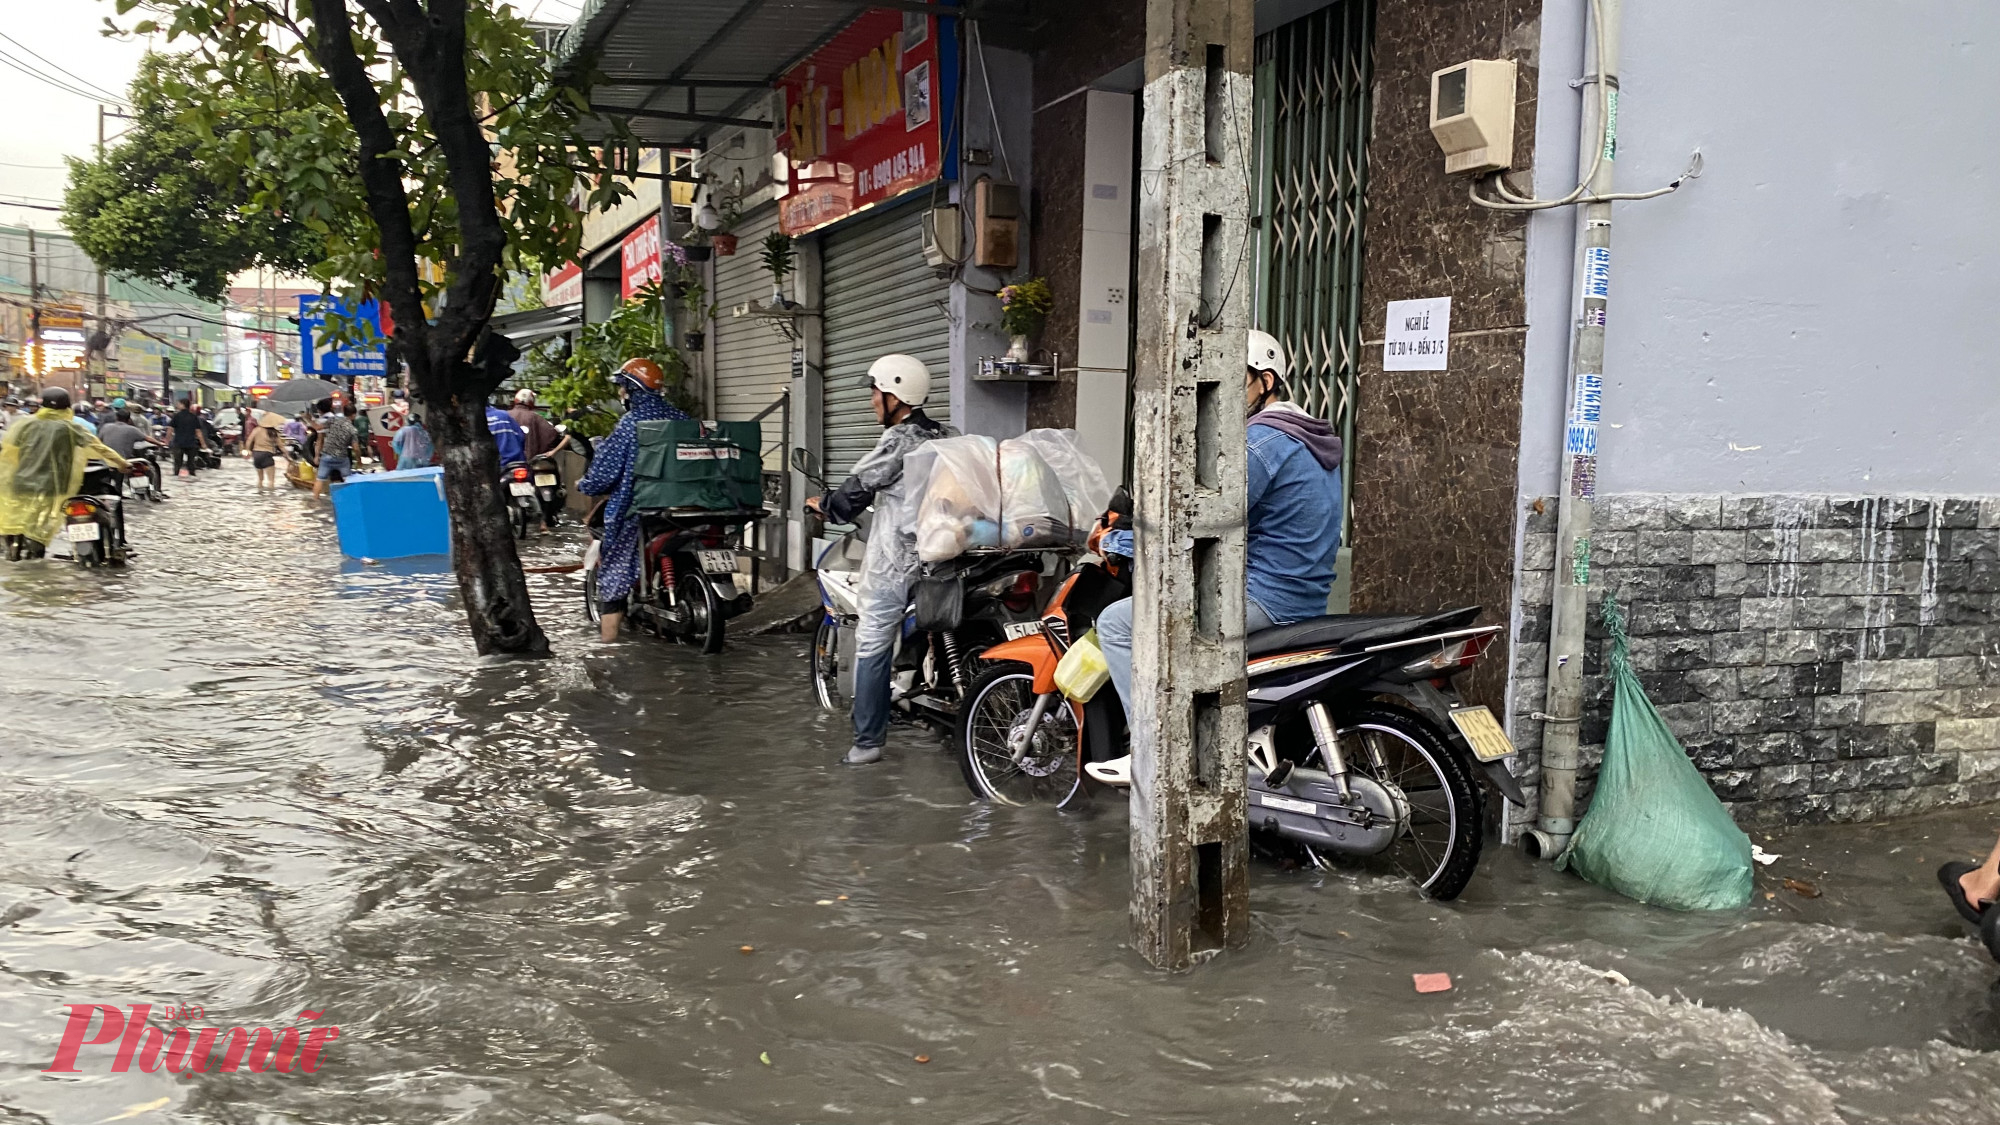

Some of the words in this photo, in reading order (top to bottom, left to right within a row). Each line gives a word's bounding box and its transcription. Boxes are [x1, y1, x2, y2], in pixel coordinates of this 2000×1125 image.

[842, 31, 904, 140] INOX
[1397, 341, 1413, 355] 30/4
[1418, 336, 1431, 355] ĐẾN
[1432, 340, 1444, 355] 3/5
